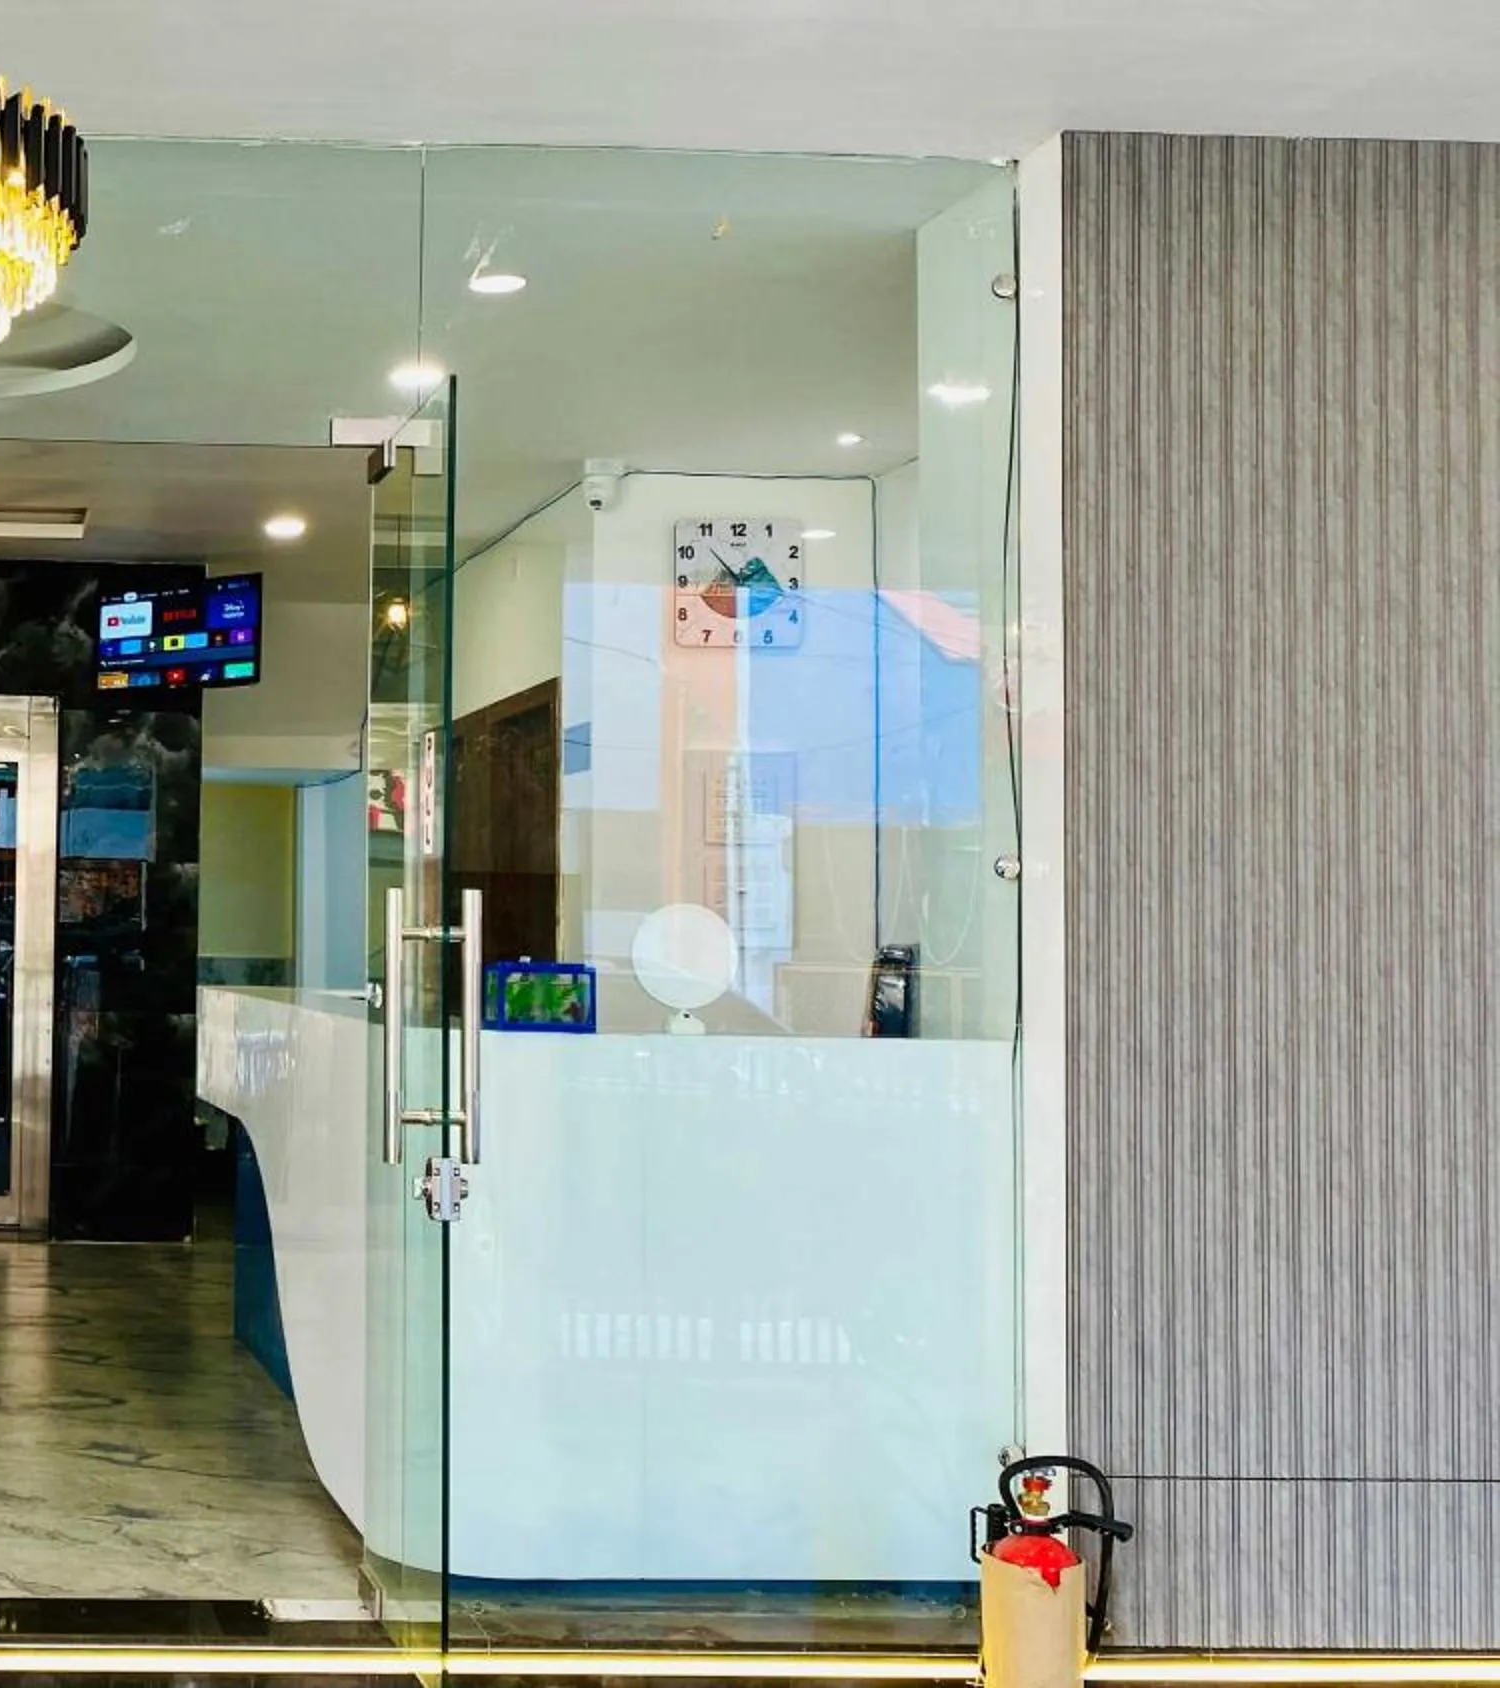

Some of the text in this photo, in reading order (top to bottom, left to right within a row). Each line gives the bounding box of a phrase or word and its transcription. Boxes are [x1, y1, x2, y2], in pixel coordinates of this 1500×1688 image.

[699, 523, 713, 537] 11
[730, 523, 747, 537] 12
[765, 523, 773, 538] 1
[678, 545, 695, 559] 10
[789, 545, 799, 559] 2
[678, 575, 688, 588] 9
[789, 577, 799, 590] 3
[678, 607, 687, 621] 8
[789, 609, 799, 624] 4
[702, 629, 712, 642] 7
[763, 629, 773, 644] 5
